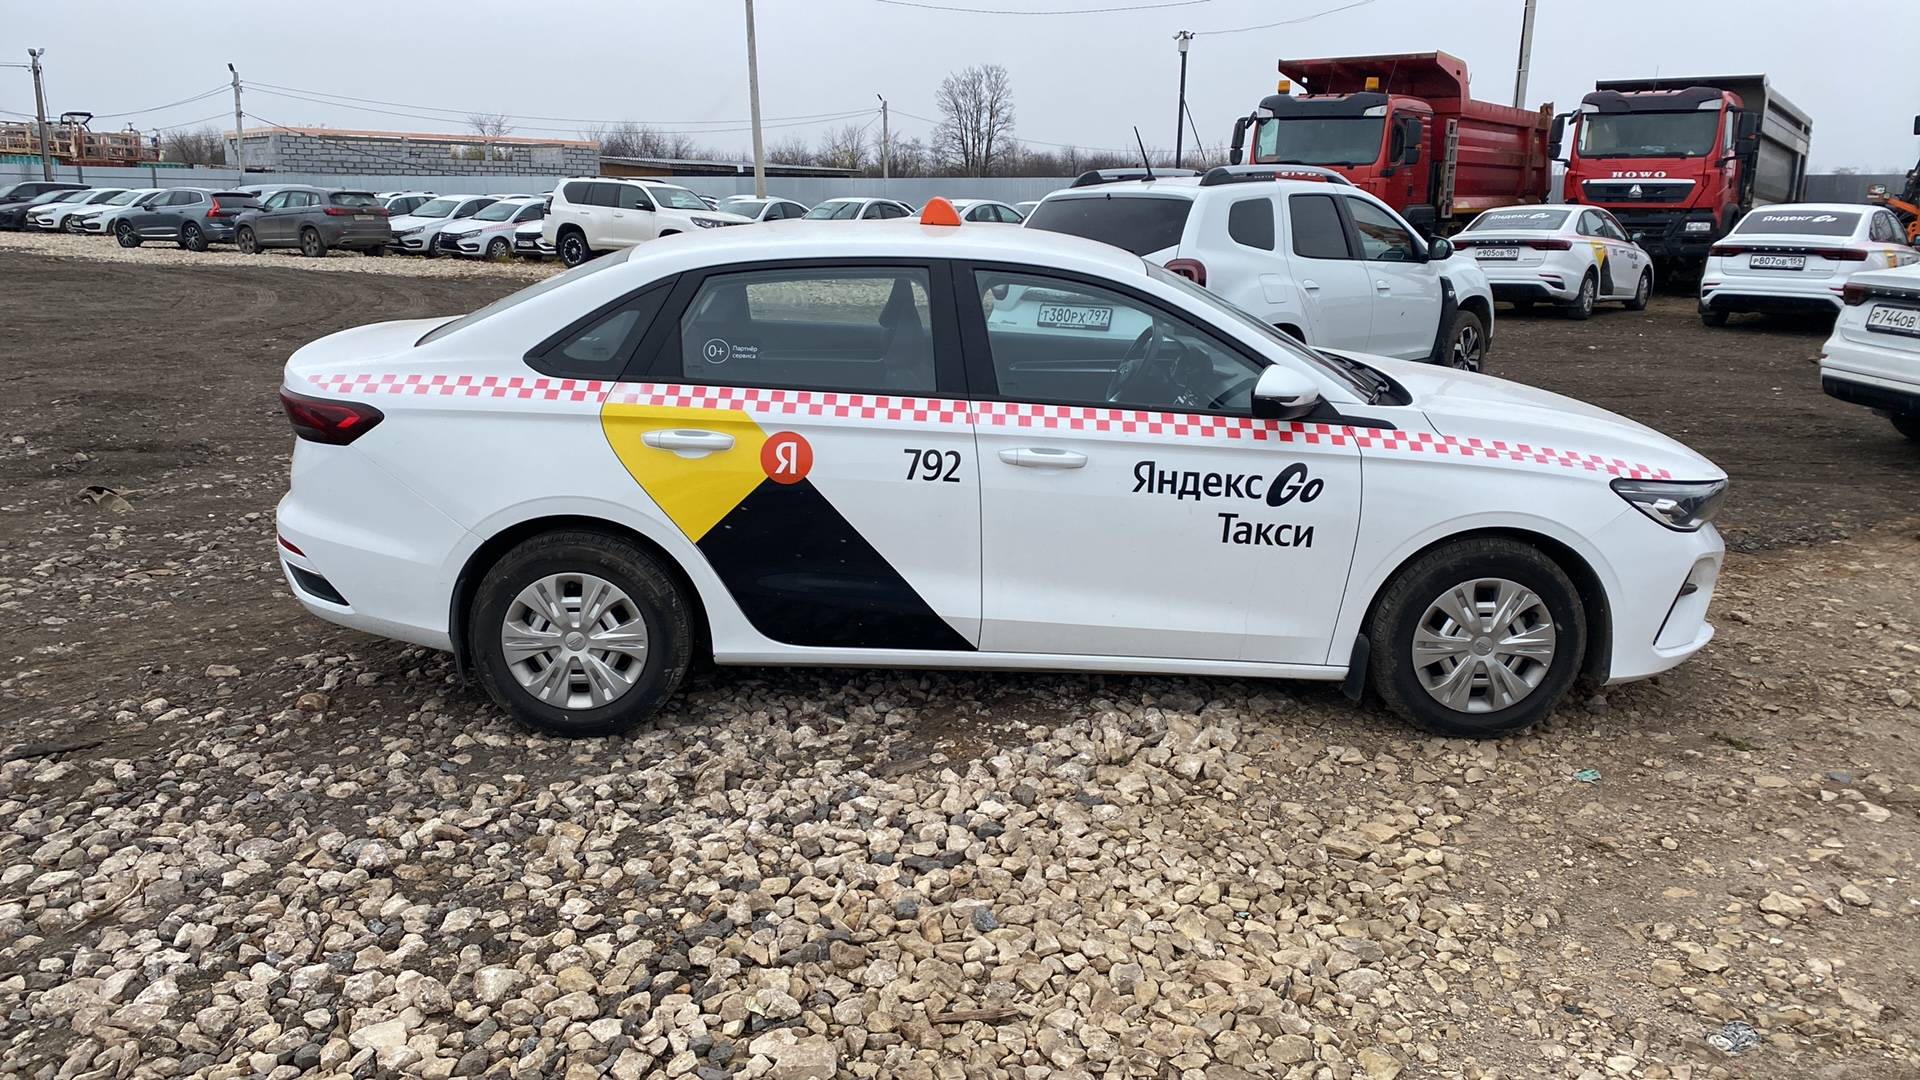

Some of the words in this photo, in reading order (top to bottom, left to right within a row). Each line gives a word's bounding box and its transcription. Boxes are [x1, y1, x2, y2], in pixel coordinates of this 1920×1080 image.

[708, 344, 725, 357] 0+
[774, 441, 798, 475] Я
[903, 448, 962, 483] 792
[1132, 460, 1264, 502] Яндекс
[1265, 461, 1325, 508] Go
[1217, 512, 1315, 548] Такси
